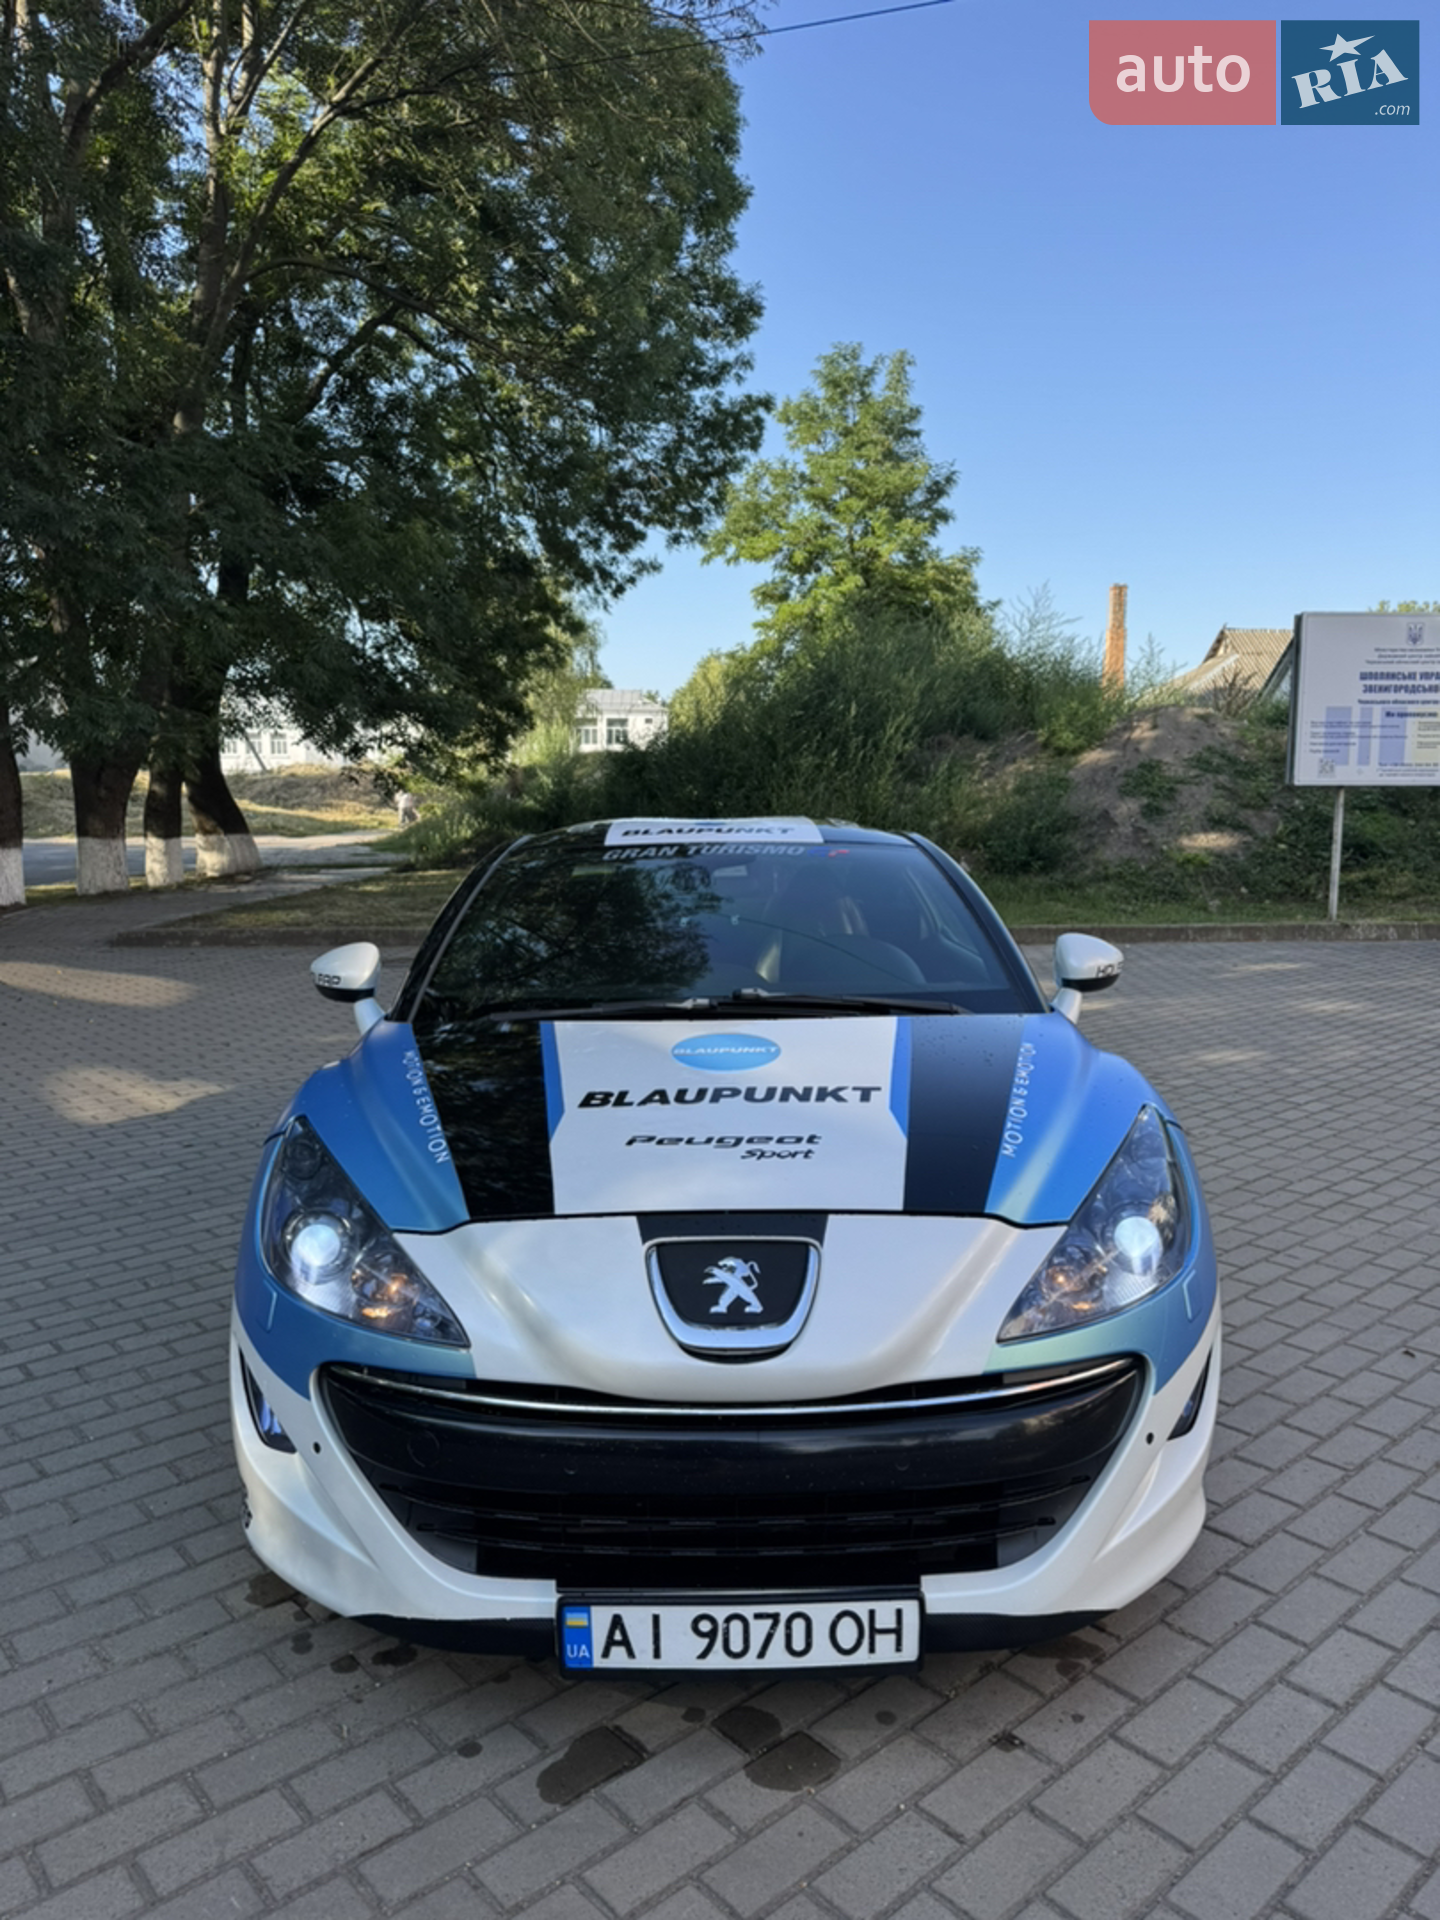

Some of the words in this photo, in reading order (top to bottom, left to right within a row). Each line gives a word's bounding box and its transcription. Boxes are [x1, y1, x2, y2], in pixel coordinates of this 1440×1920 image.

[620, 826, 796, 838] BLAUPUNKT
[602, 845, 678, 861] GRAN
[686, 842, 806, 858] TURISMO
[673, 1046, 777, 1056] BLAUPUNKT
[577, 1086, 882, 1109] BLAUPUNKT
[625, 1134, 822, 1149] Peugeot
[600, 1613, 661, 1659] AI
[690, 1611, 813, 1659] 9070
[828, 1608, 903, 1656] OH
[566, 1644, 591, 1659] UA
